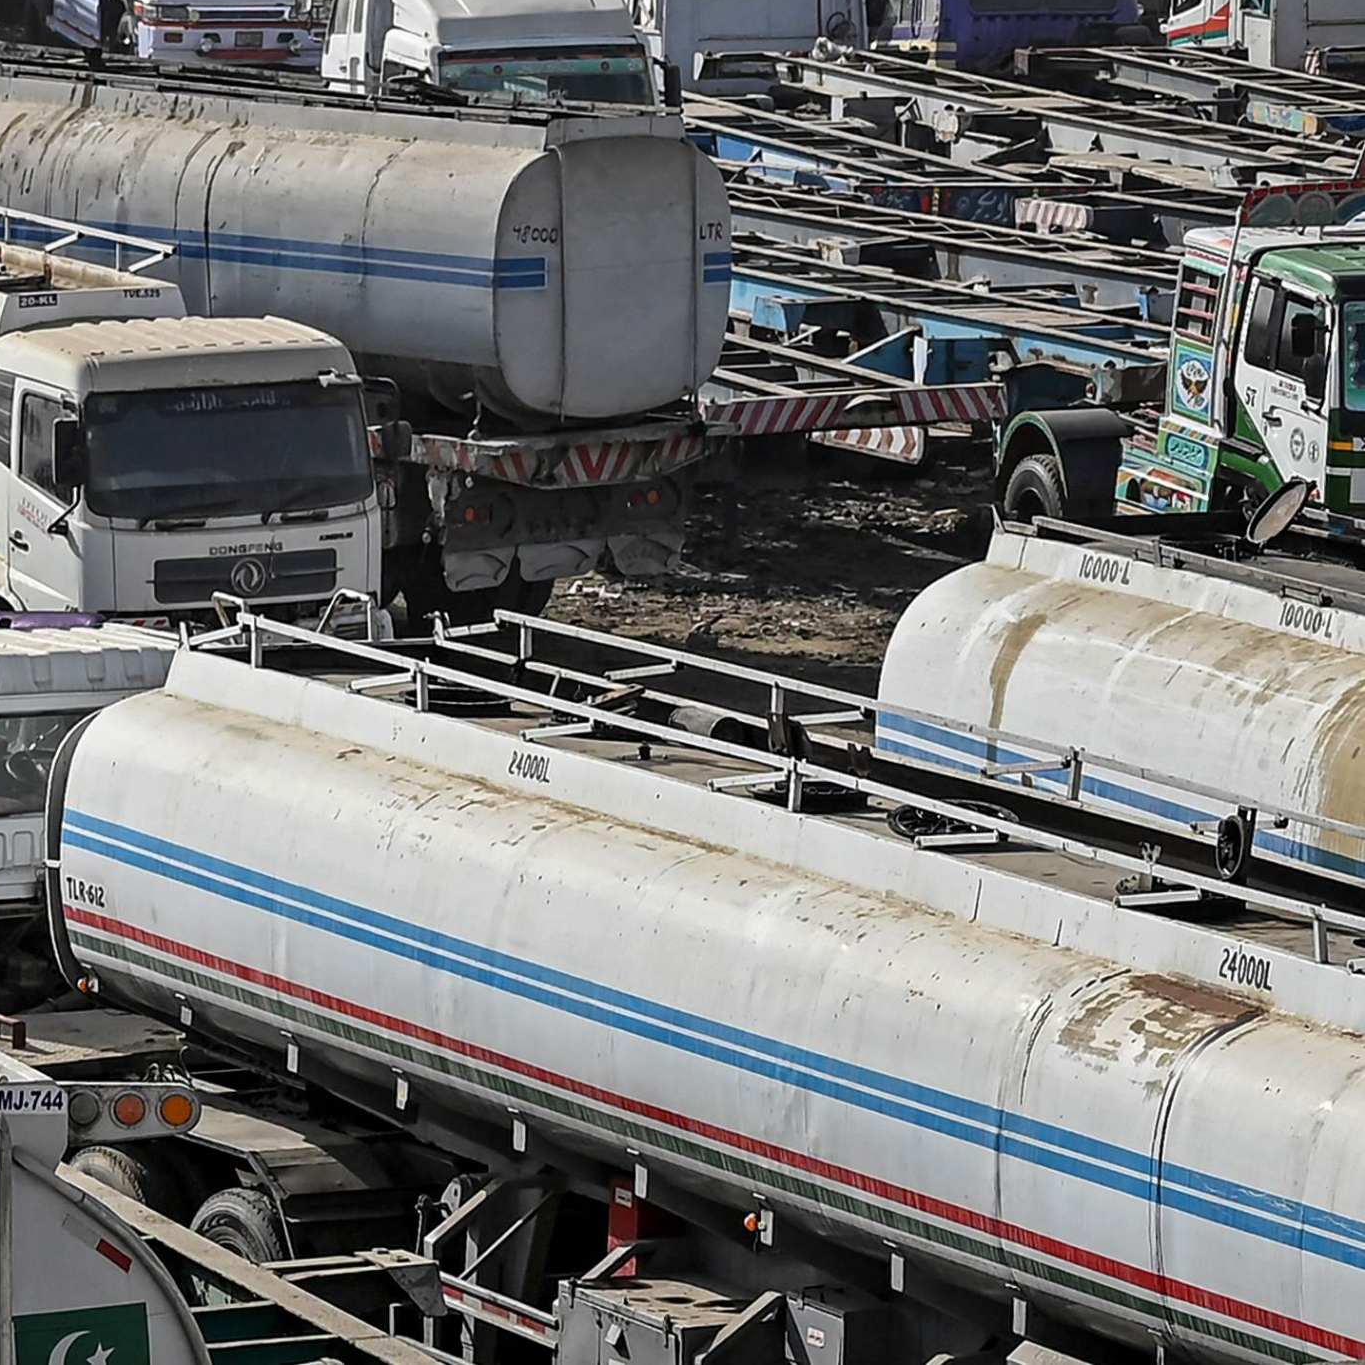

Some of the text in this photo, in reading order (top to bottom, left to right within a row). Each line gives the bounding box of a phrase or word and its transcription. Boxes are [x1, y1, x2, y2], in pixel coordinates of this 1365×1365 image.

[513, 222, 724, 244] 48000 LTR
[208, 542, 284, 557] DONGFENG
[1218, 947, 1273, 991] 24000L
